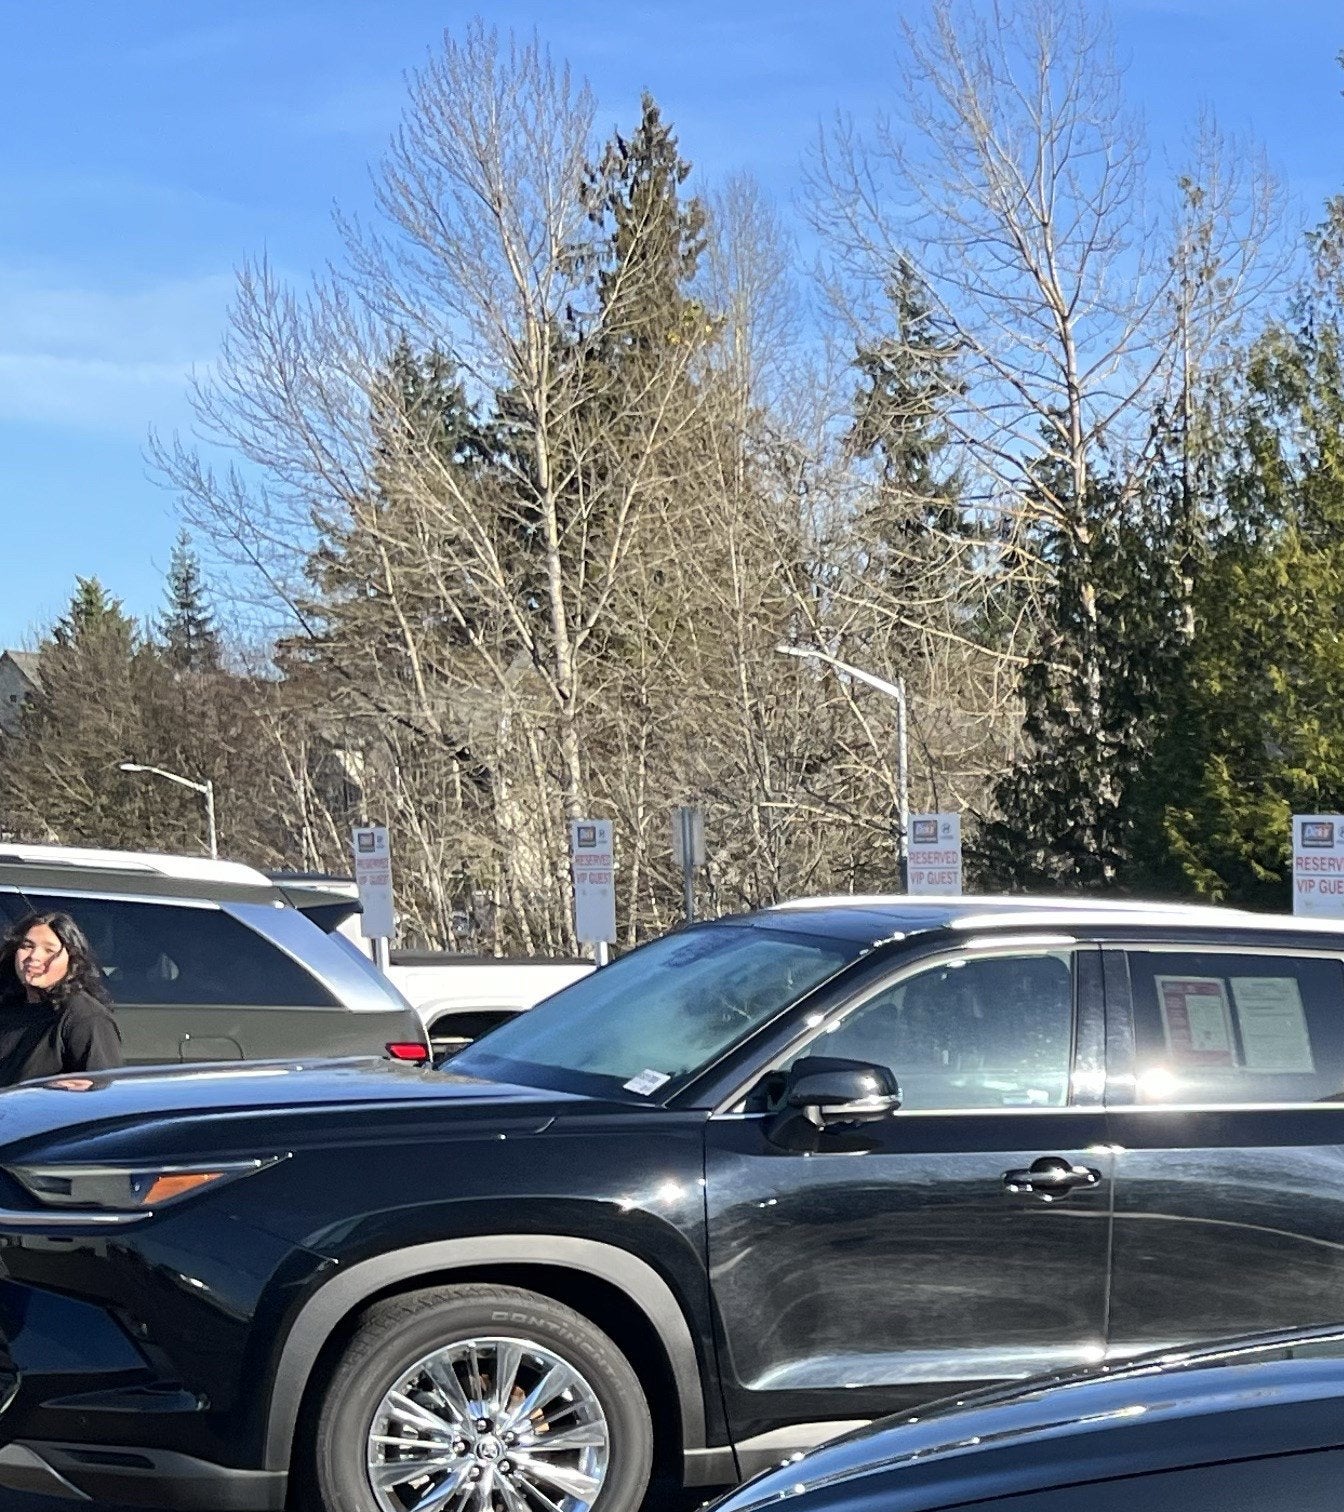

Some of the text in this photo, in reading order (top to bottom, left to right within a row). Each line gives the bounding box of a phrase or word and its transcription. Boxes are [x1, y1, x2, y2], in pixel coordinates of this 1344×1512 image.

[909, 850, 958, 865] RESERVED
[910, 870, 959, 885] VIP GUEST
[1296, 878, 1316, 895] VIP
